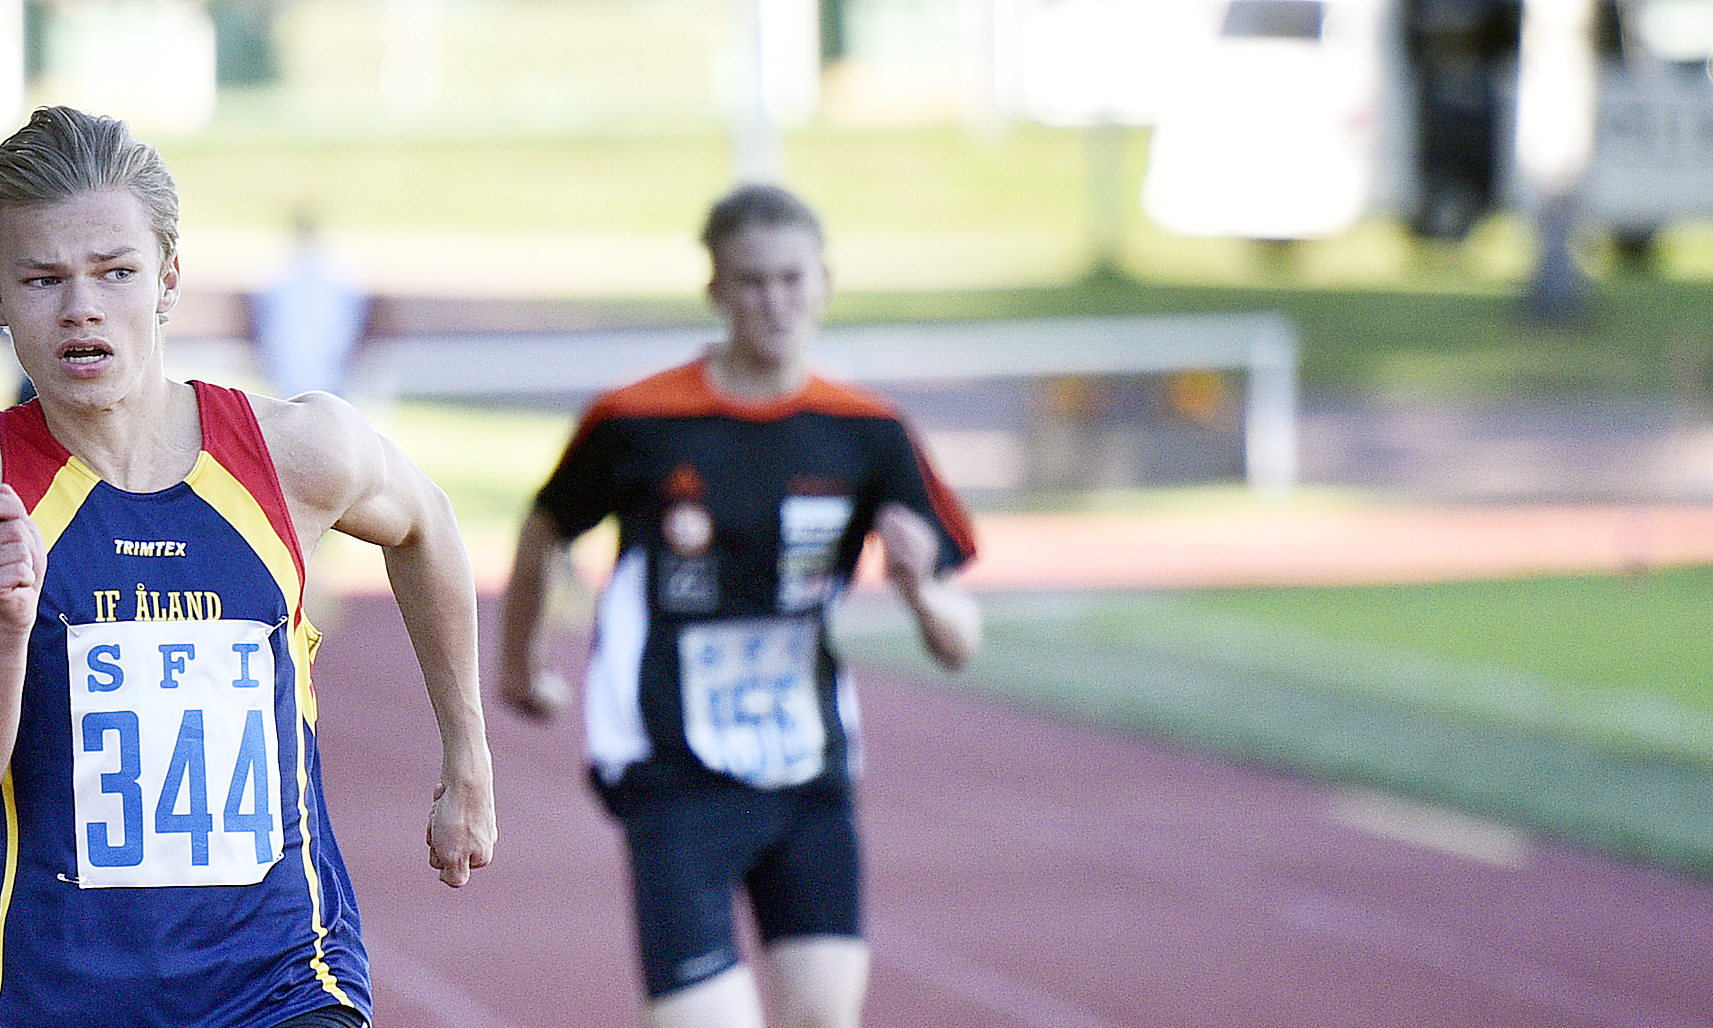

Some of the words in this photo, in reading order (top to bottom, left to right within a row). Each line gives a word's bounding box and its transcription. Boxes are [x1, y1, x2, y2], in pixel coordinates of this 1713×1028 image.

[114, 539, 186, 557] TRIMTEX
[93, 590, 121, 622] IF
[135, 583, 222, 621] ÅLAND
[82, 709, 274, 868] 344
